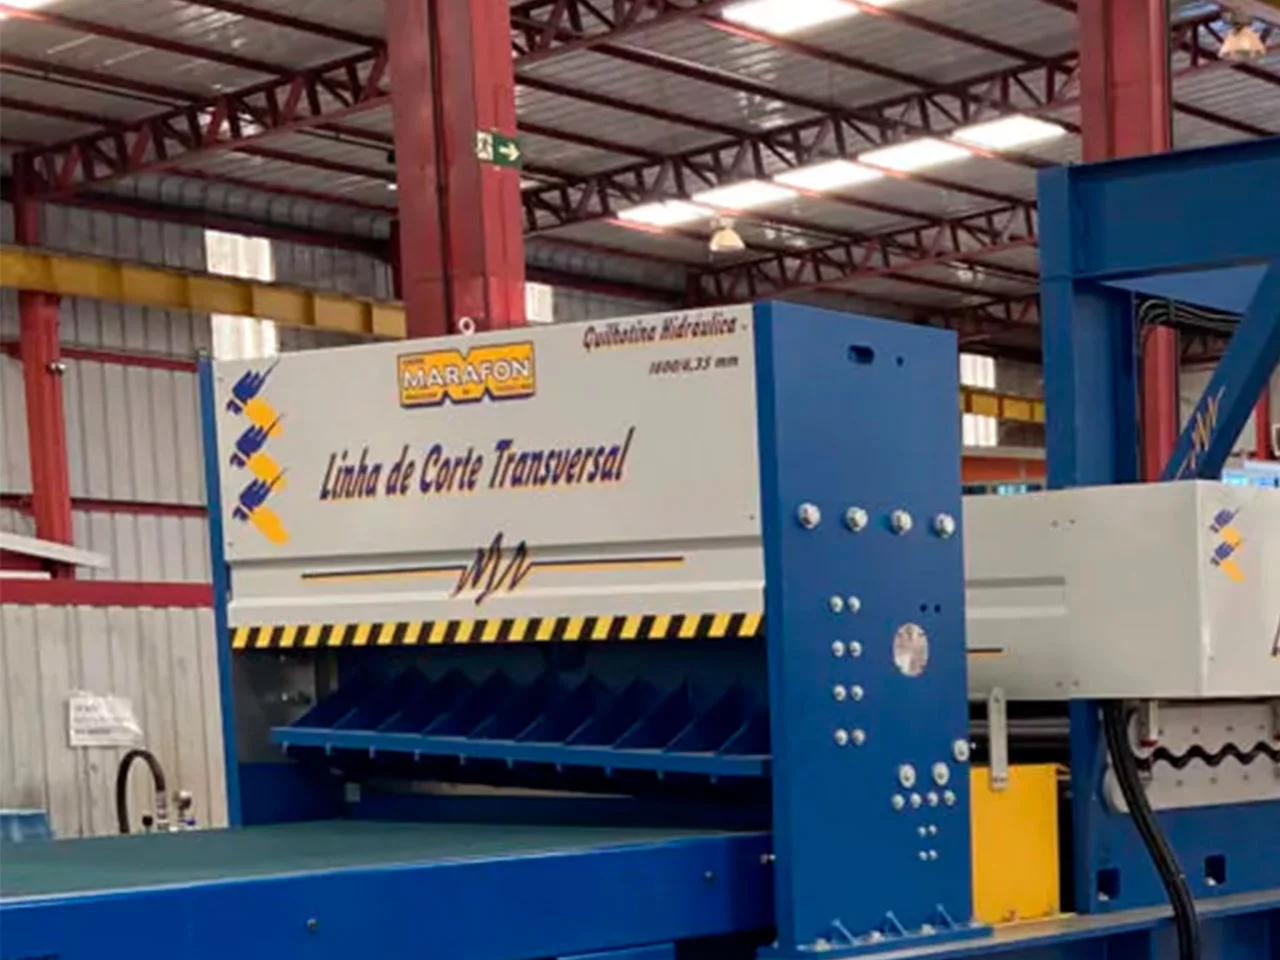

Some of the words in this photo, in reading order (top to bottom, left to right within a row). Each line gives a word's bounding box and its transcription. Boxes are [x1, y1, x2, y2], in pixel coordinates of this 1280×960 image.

[403, 359, 529, 389] MARAFON
[714, 355, 739, 369] mm
[319, 448, 383, 501] Linha
[385, 444, 415, 497] de
[419, 444, 484, 494] Corte
[488, 425, 637, 490] Transversal
